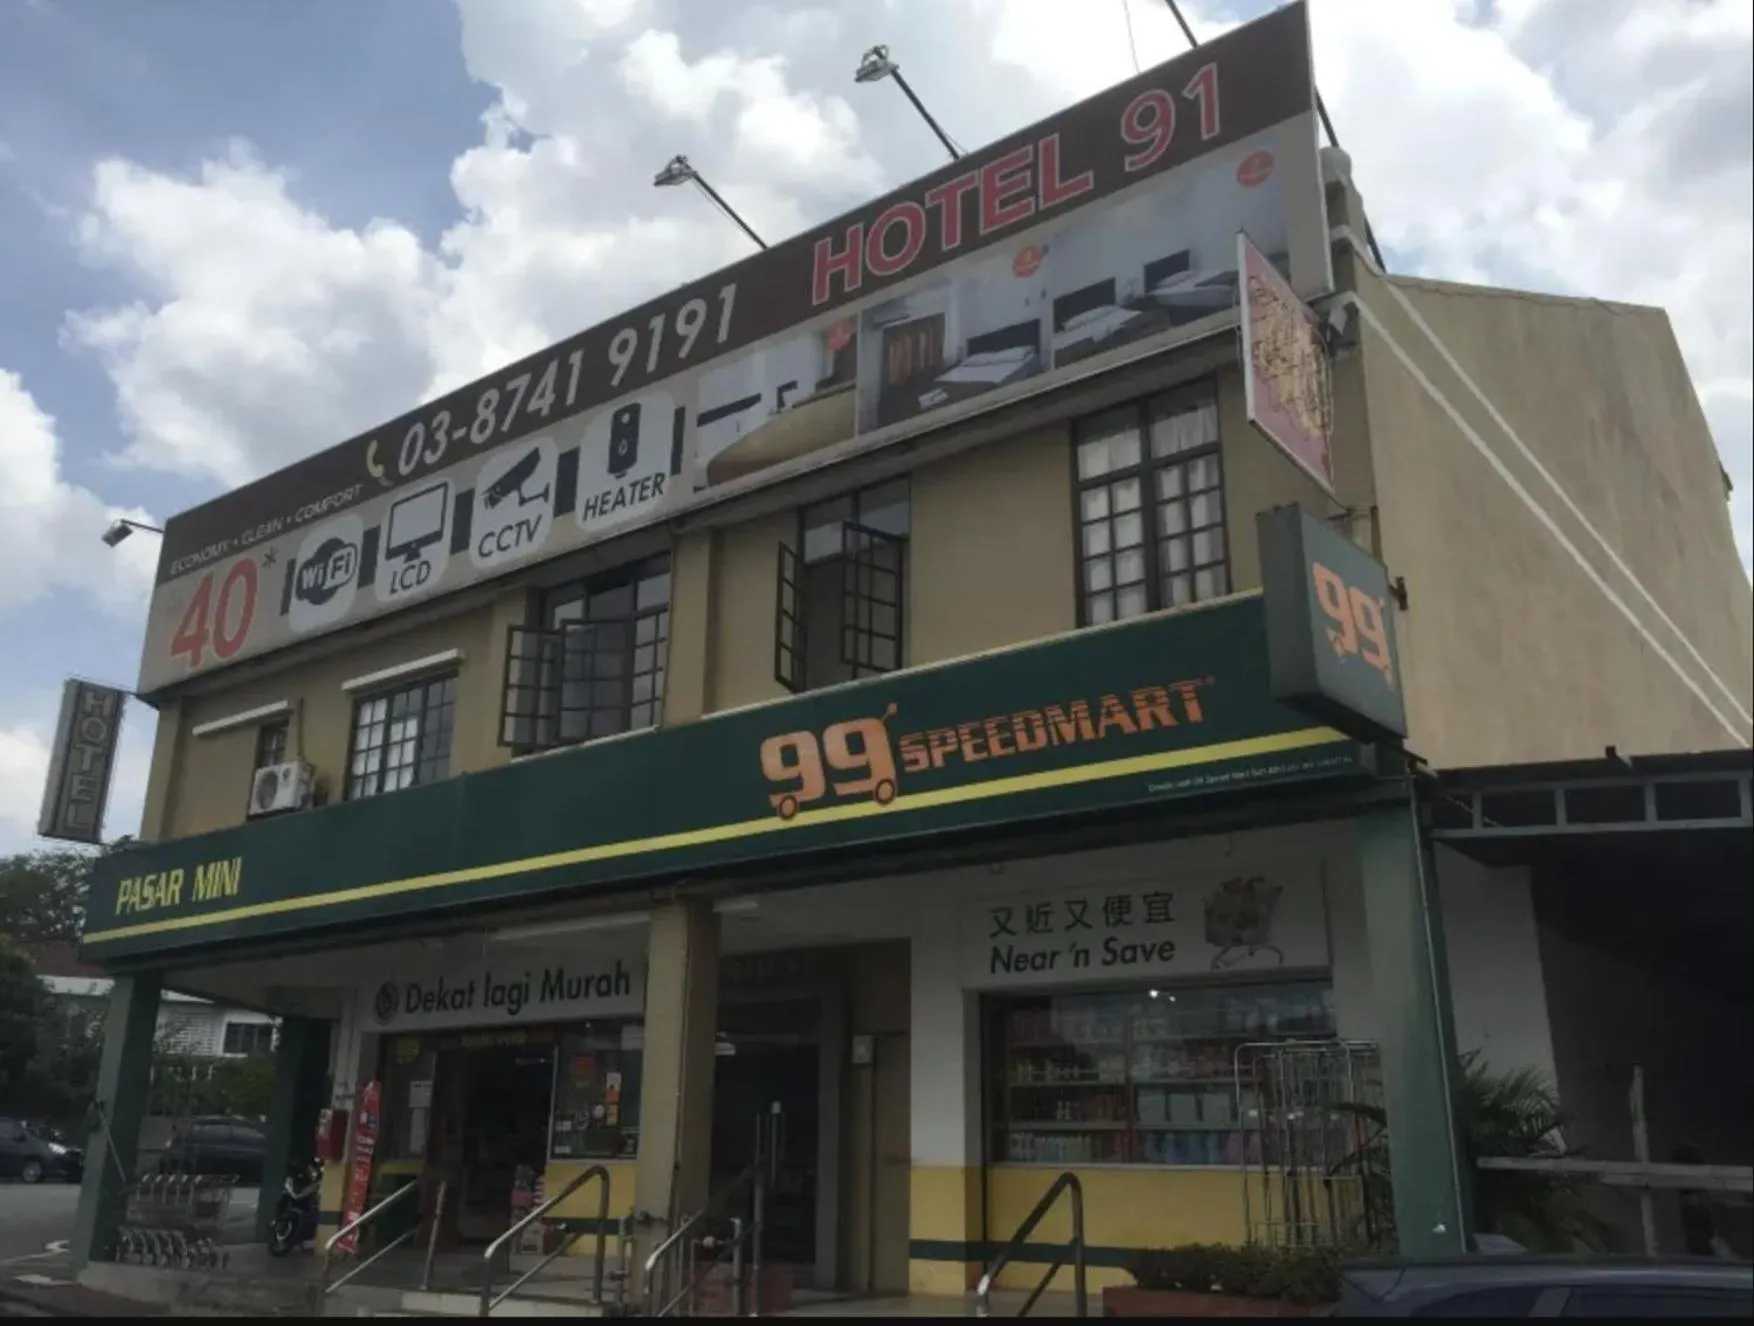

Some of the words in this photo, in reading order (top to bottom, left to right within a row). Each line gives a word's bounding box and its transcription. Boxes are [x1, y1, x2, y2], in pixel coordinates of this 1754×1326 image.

[812, 133, 1094, 308] HOTEL
[1120, 62, 1222, 173] 91
[397, 349, 584, 477] 03-8741
[607, 283, 737, 388] 9191
[582, 471, 667, 522] HEATER
[241, 516, 284, 546] CLEAN
[477, 515, 543, 559] CCTV
[389, 558, 432, 595] LCD
[1312, 561, 1393, 682] 99
[64, 689, 114, 833] HOTEL
[760, 714, 899, 813] 99
[899, 678, 1208, 774] SPEEDMART
[114, 868, 185, 916] PASAR
[191, 856, 242, 903] MINI
[988, 890, 1176, 940] 又近又便宜
[989, 944, 1061, 974] Near
[1101, 935, 1176, 967] Save
[404, 976, 477, 1015] Dekat
[483, 971, 533, 1016] lagi
[539, 959, 631, 1004] Murah
